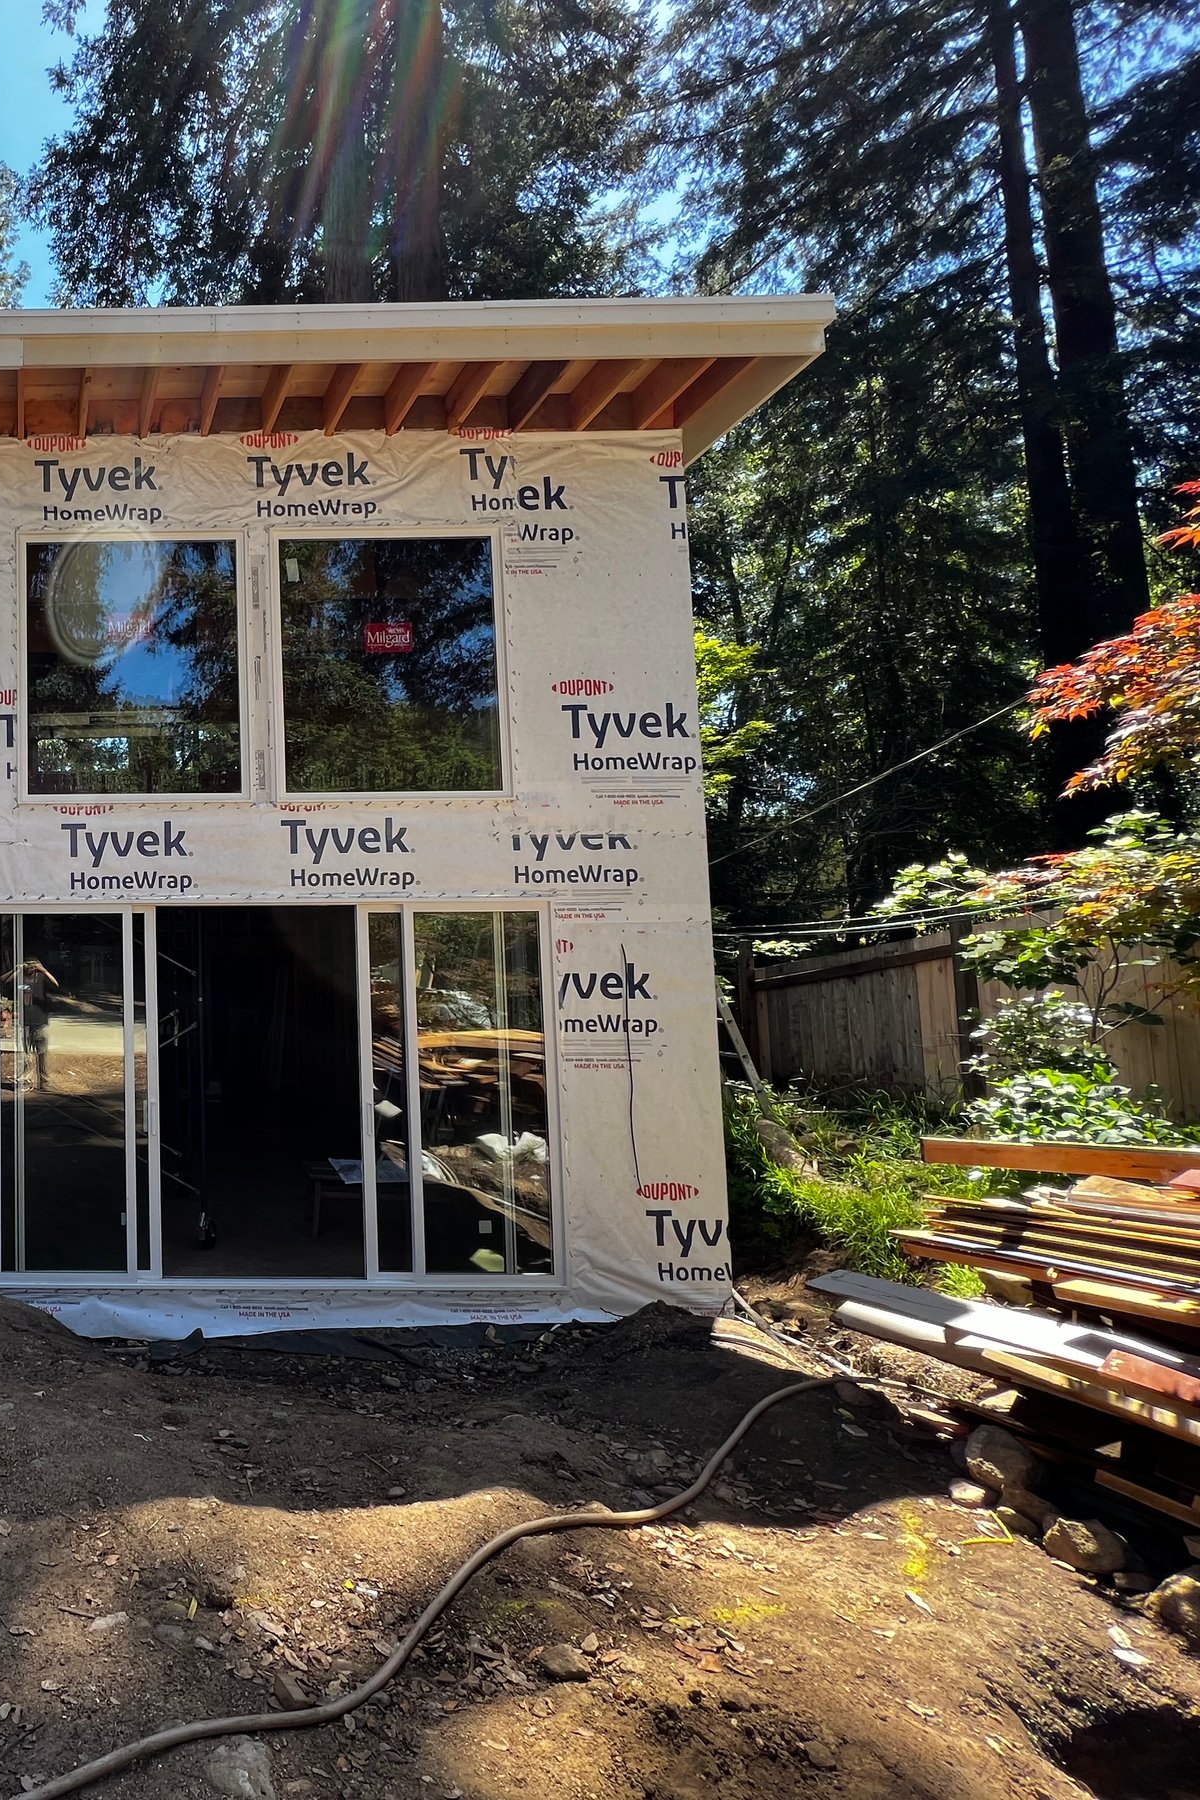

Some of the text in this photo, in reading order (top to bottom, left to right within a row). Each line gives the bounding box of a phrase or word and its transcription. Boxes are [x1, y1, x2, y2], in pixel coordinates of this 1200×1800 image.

[34, 435, 80, 452] DUPONT
[246, 432, 292, 449] DUPONT
[34, 457, 157, 501] Tyvek
[247, 452, 371, 497] Tyvek
[43, 504, 162, 524] HomeWrap
[256, 499, 377, 518] HomeWrap
[367, 630, 410, 648] Milgard
[560, 679, 607, 696] DUPONT
[561, 702, 690, 748] Tyvek
[573, 752, 697, 774] HomeWrap
[61, 821, 188, 868] Tyvek
[280, 817, 409, 864] Tyvek
[70, 871, 192, 893] HomeWrap
[291, 868, 415, 889] HomeWrap
[514, 864, 638, 886] HomeWrap
[643, 1183, 692, 1200] DUPONT
